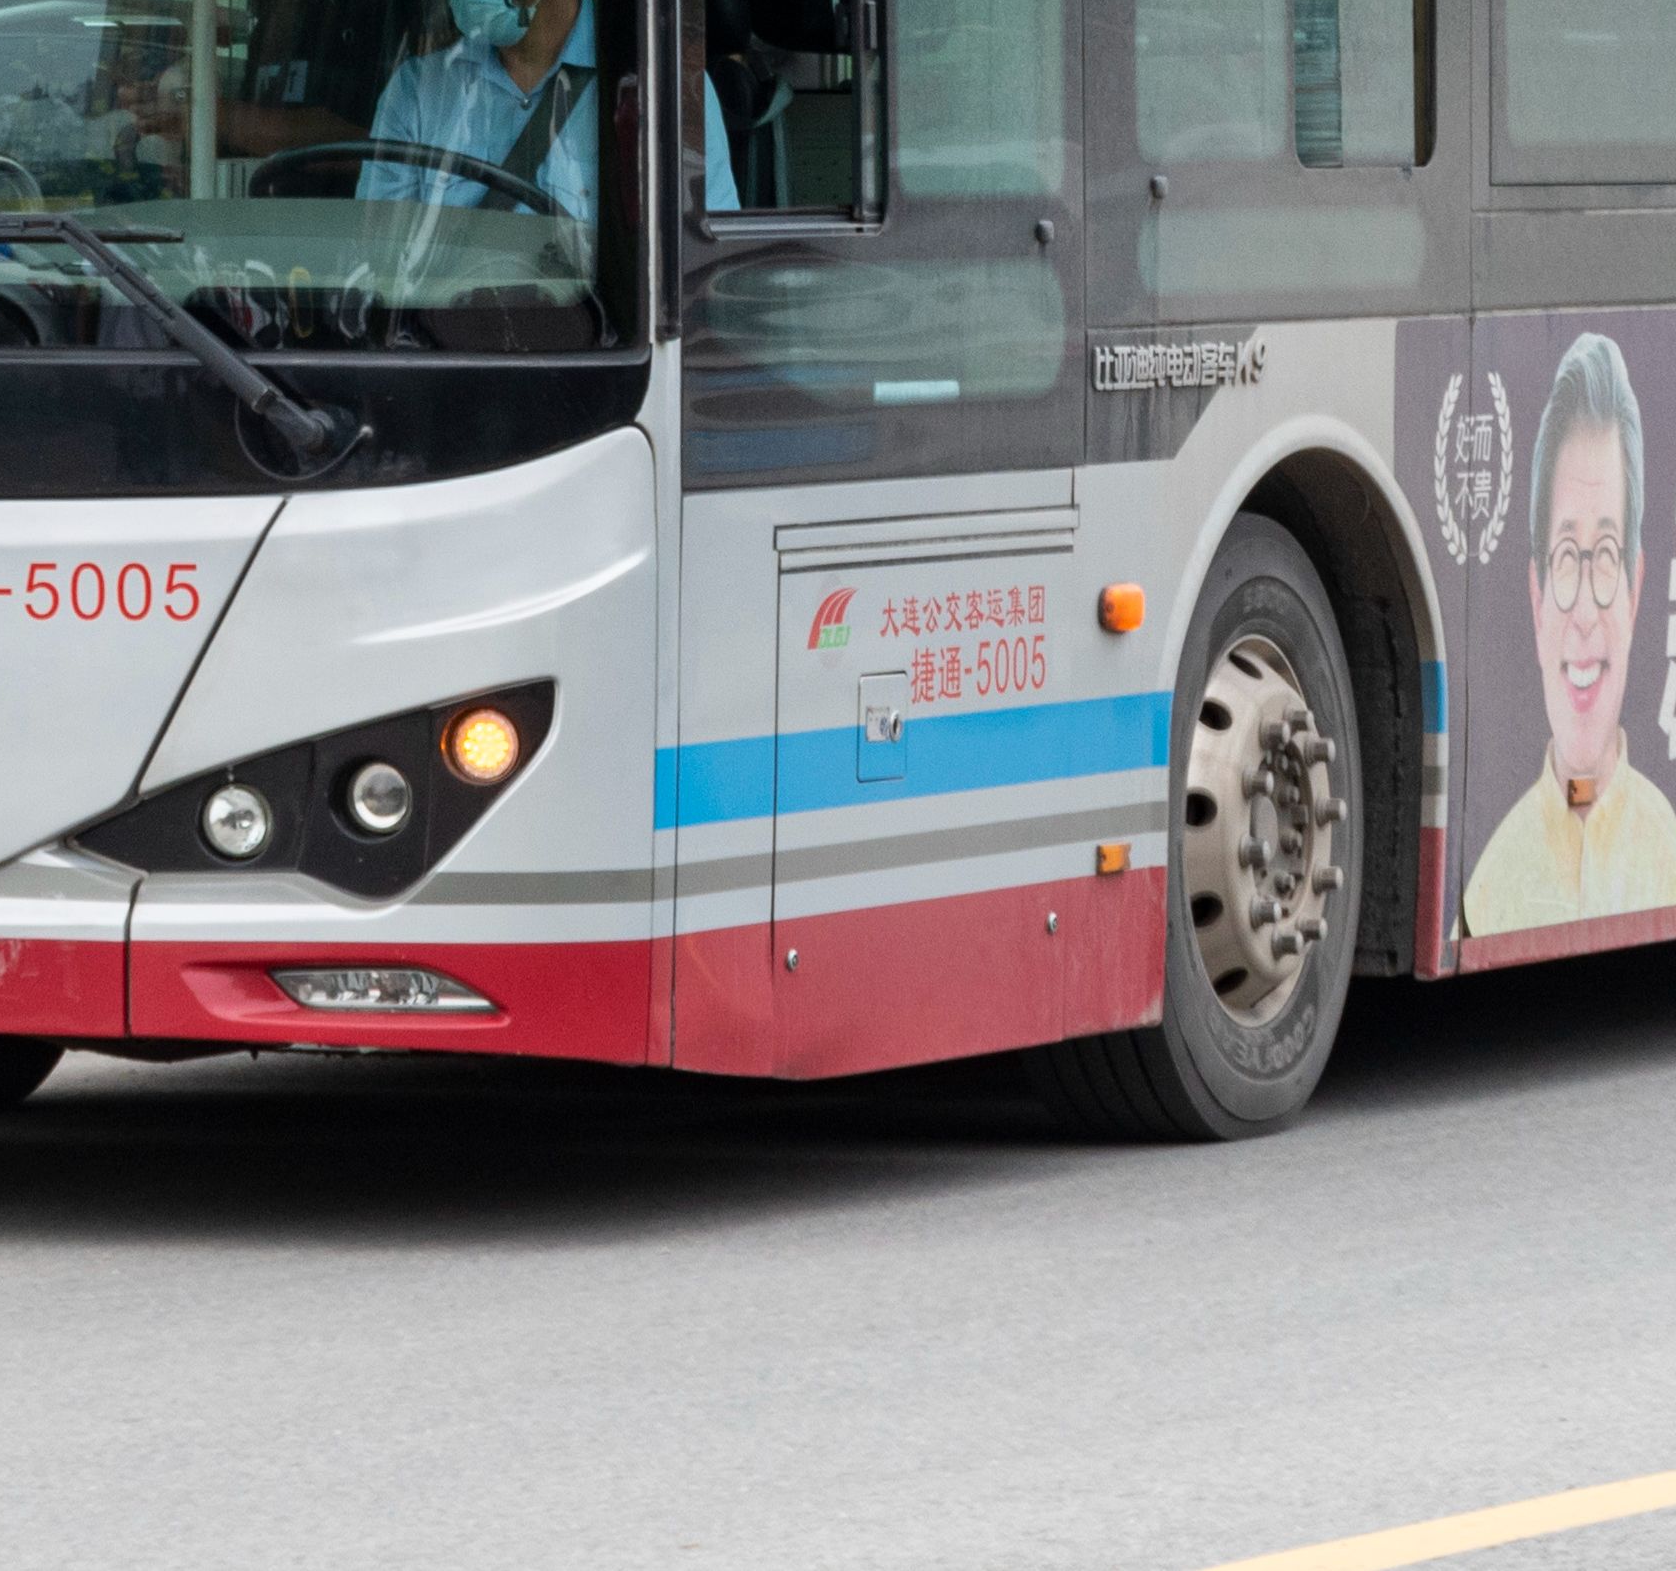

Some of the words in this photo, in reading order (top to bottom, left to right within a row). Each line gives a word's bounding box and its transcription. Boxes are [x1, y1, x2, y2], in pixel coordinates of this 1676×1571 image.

[880, 585, 1046, 637] 大连公交客运集团
[910, 635, 1047, 704] 捷通-5005
